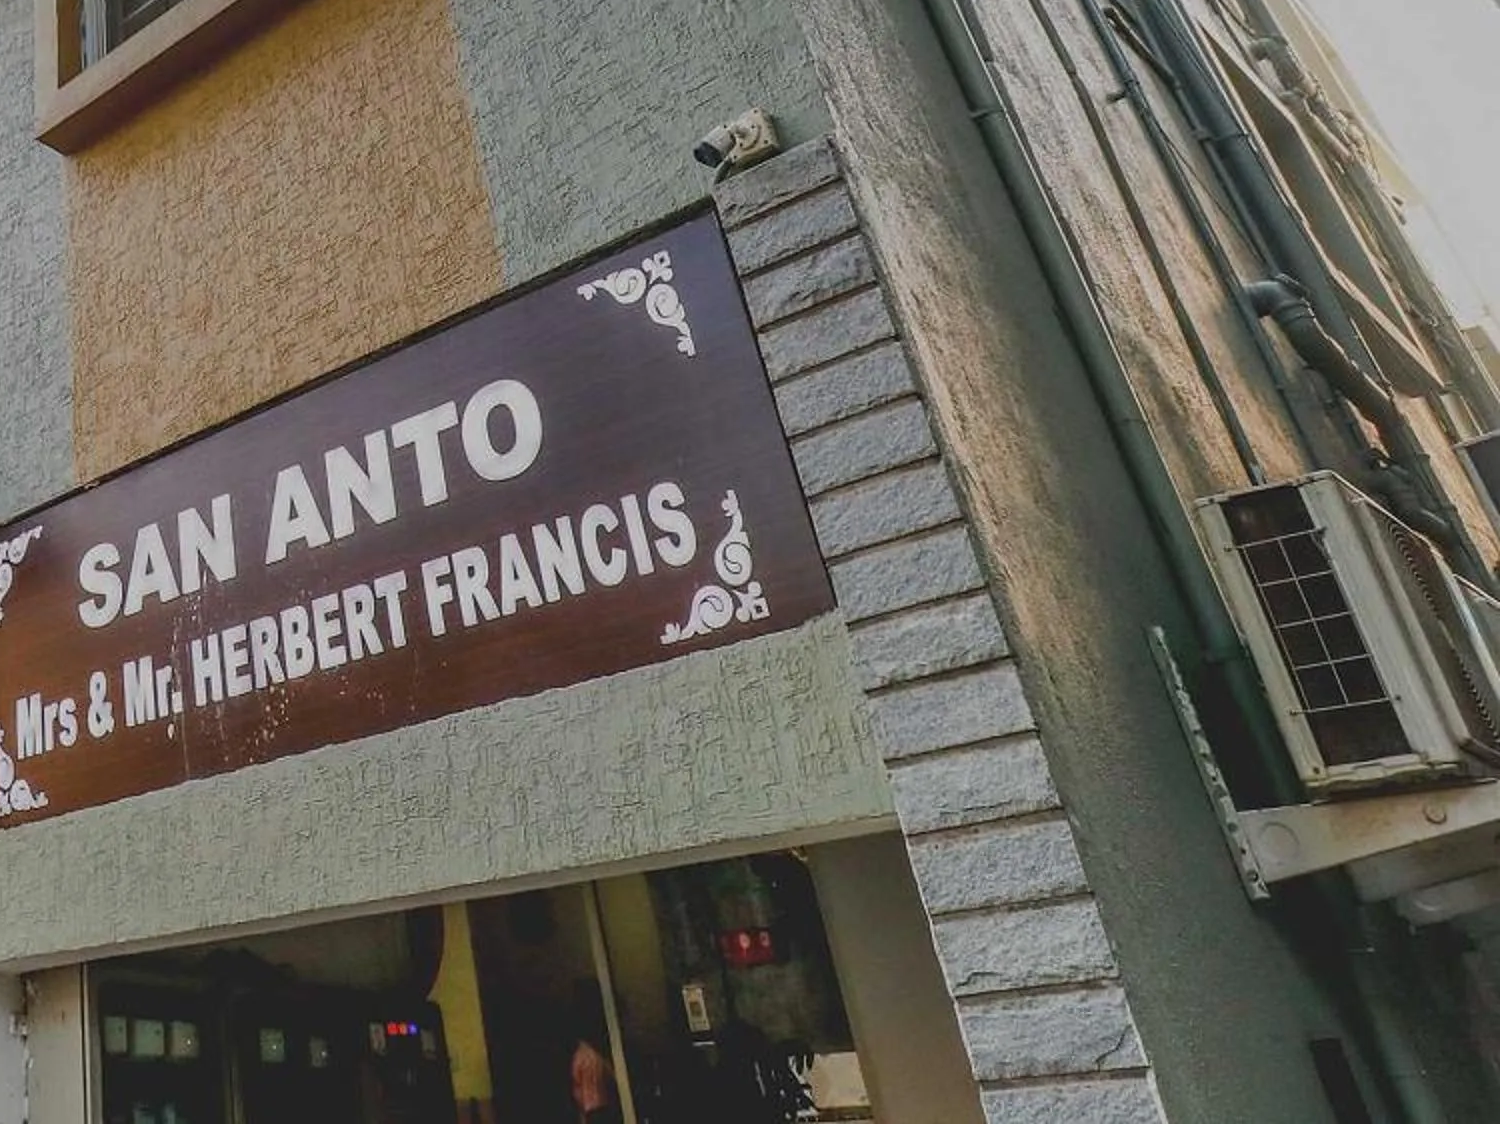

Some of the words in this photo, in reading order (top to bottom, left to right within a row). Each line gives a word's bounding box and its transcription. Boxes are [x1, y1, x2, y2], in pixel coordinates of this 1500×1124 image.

[16, 692, 78, 760] Mrs
[87, 672, 115, 738] &
[123, 656, 183, 727] Mr.
[192, 571, 407, 707] HERBERT
[421, 482, 697, 637] FRANCIS
[78, 493, 237, 628] SAN
[265, 379, 543, 565] ANTO
